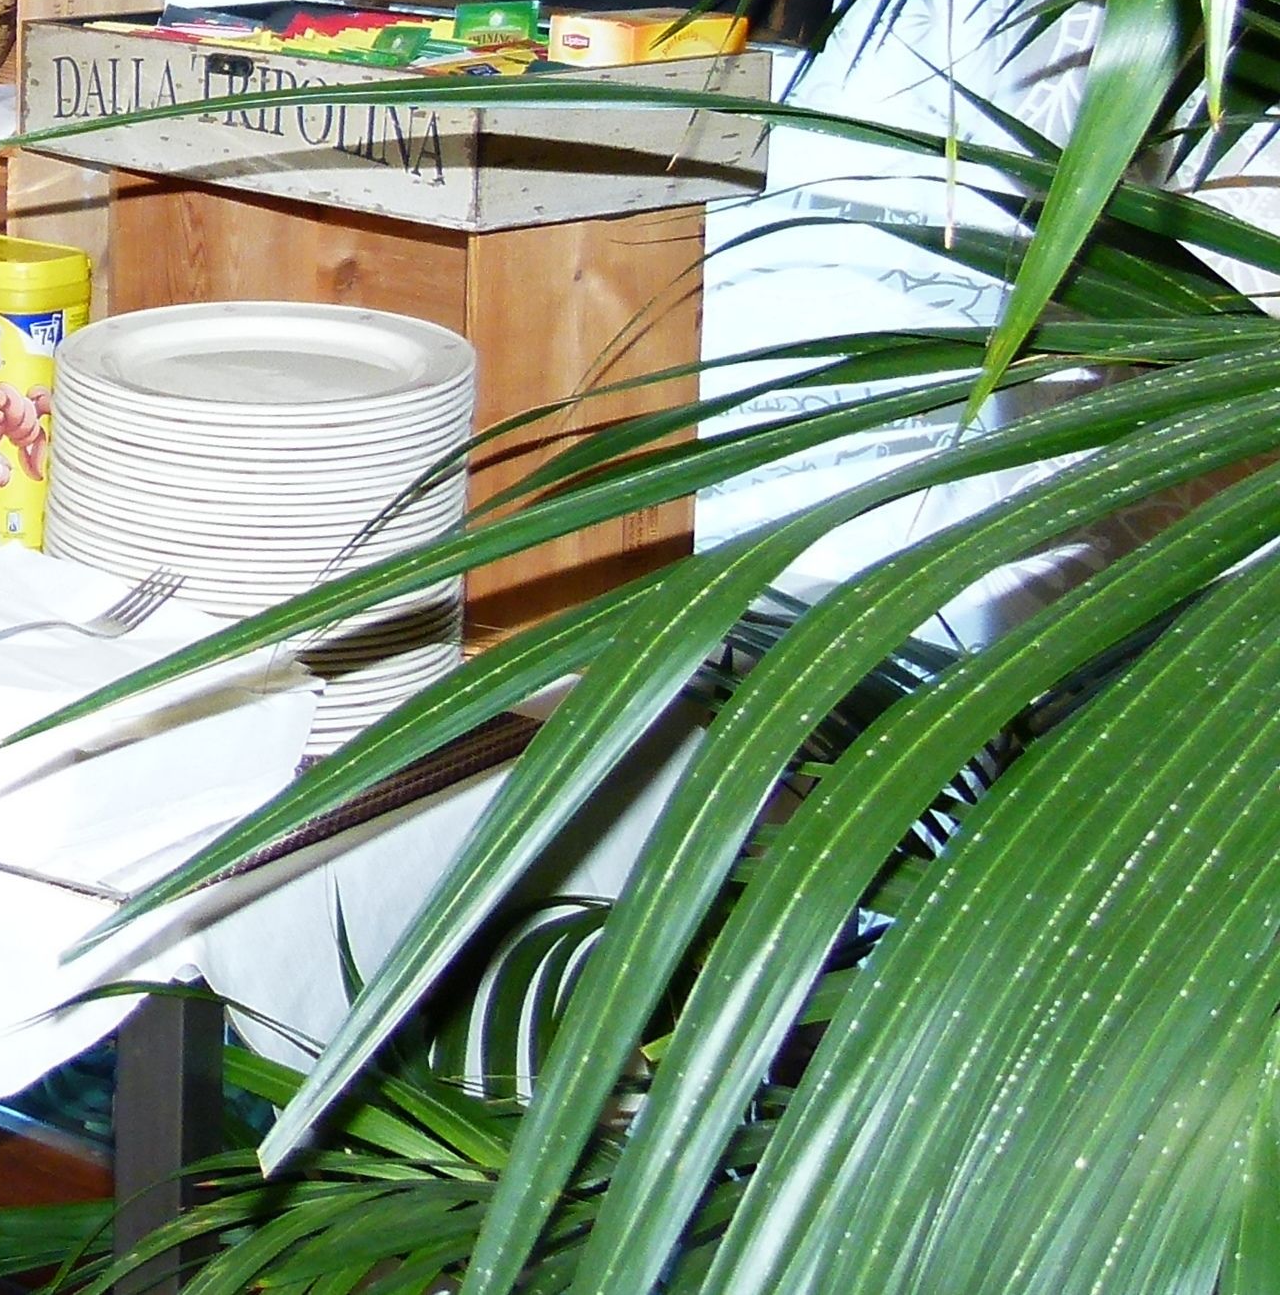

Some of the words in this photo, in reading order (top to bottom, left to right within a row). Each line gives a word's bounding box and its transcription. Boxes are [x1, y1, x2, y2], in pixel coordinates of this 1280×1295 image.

[468, 32, 515, 45] WININ
[52, 56, 179, 119] DALLA
[190, 53, 446, 186] TRIPOLINA
